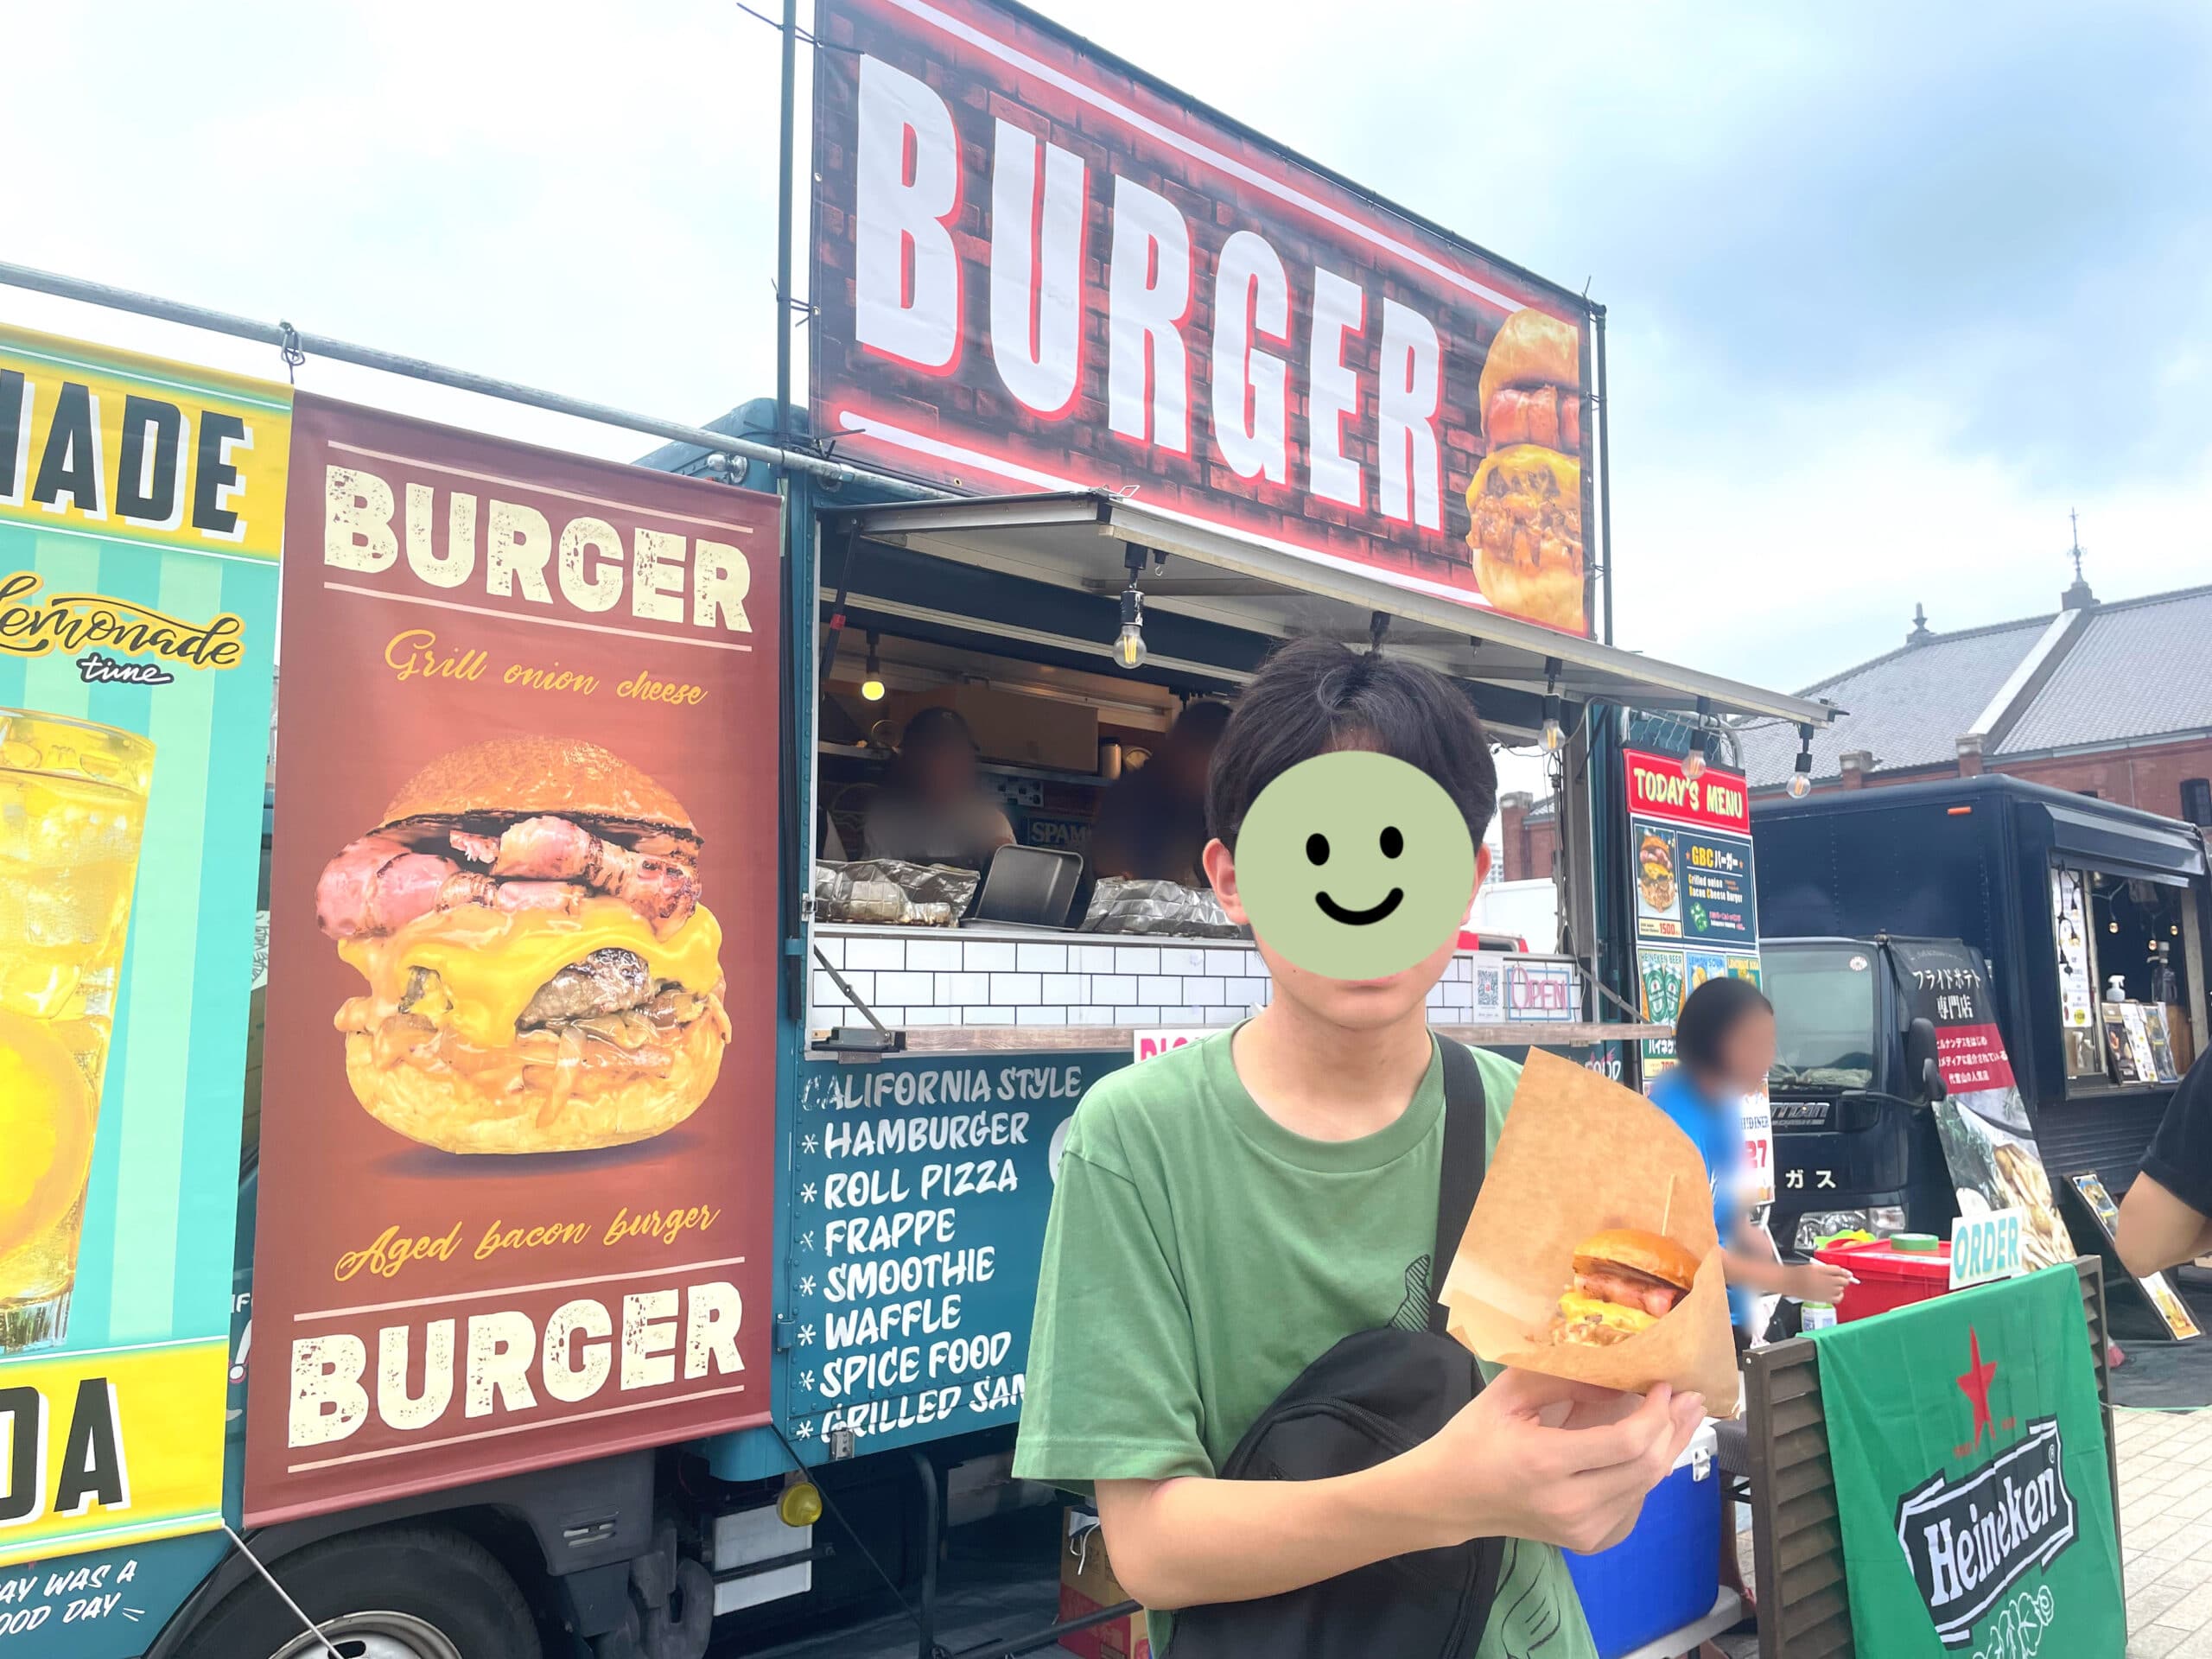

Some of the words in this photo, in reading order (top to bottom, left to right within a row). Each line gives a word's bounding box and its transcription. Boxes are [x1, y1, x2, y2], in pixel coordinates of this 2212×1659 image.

[855, 53, 1440, 531] BURGER
[324, 465, 753, 632] BURGER
[81, 654, 173, 683] time
[385, 629, 487, 681] Grill
[503, 661, 600, 695] onion
[616, 671, 708, 705] cheese
[1633, 767, 1700, 812] TODAY'S
[1707, 784, 1743, 819] MENU
[1031, 822, 1088, 844] SPAM
[1659, 923, 1675, 936] 1500
[1912, 968, 1981, 990] フライドポテト
[1936, 995, 1974, 1020] 専門店
[996, 1065, 1081, 1101] STYLE
[824, 1110, 1030, 1160] HAMBURGER
[824, 1168, 910, 1210] ROLL
[921, 1159, 1019, 1201] PIZZA
[334, 1222, 463, 1281] Aged
[474, 1219, 592, 1261] bacon
[603, 1205, 721, 1245] burger
[824, 1208, 956, 1257] FRAPPE
[1954, 1217, 2020, 1280] ORDER
[823, 1246, 995, 1302] SMOOTHIE
[825, 1294, 961, 1351] WAFFLE
[289, 1281, 745, 1449] BURGER
[820, 1346, 920, 1398] SPICE
[929, 1332, 1012, 1378] FOOD
[821, 1386, 962, 1444] GRILLED
[1923, 1468, 2057, 1607] Heineken
[0, 1576, 38, 1605] AY
[43, 1564, 111, 1597] WAS
[117, 1560, 138, 1584] A
[62, 1592, 122, 1624] DAY
